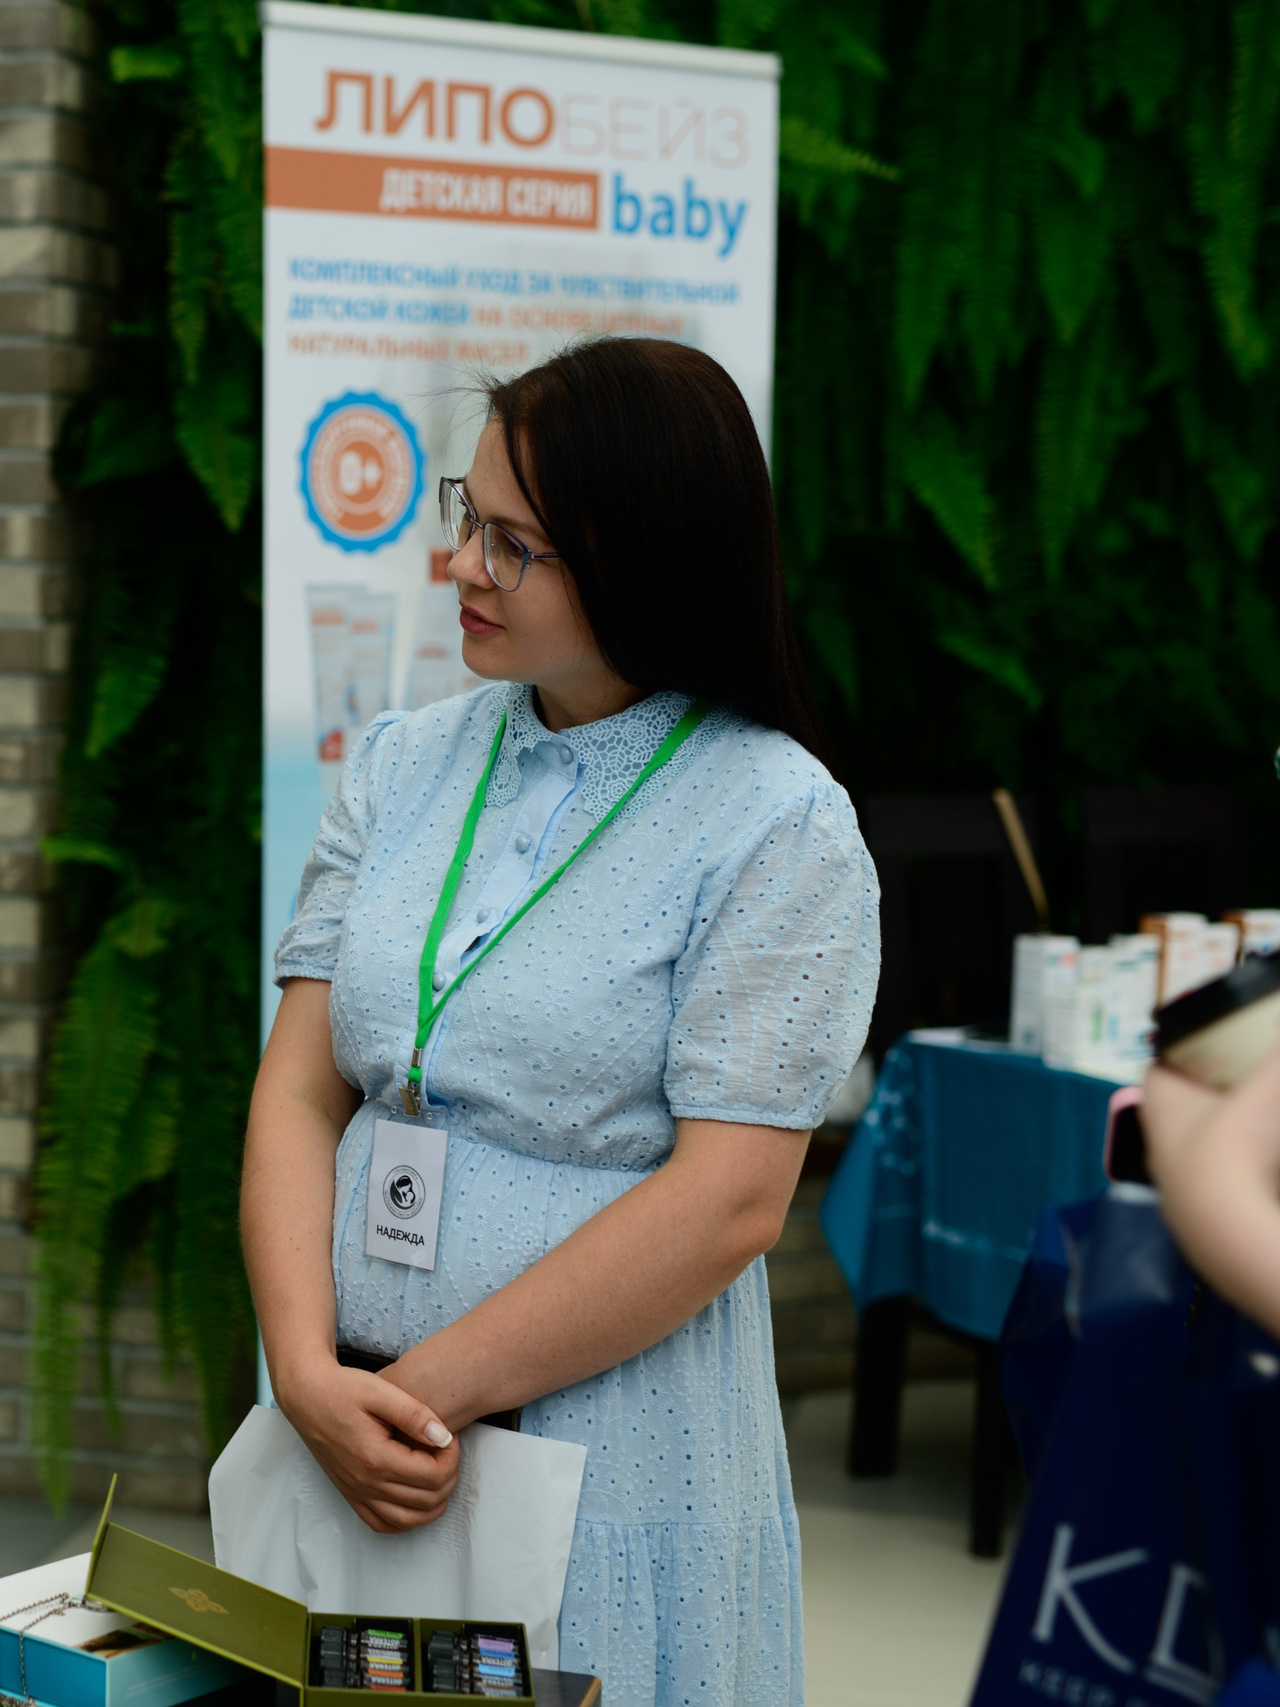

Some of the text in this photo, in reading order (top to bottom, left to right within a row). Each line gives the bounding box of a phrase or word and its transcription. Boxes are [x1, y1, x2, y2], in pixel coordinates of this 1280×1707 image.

[379, 167, 593, 221] ДЕТСКАЯ СЕРИЯ
[611, 172, 748, 259] baby
[287, 293, 390, 324] ДЕТСКОЙ
[376, 1224, 425, 1247] НАДЕЖДА
